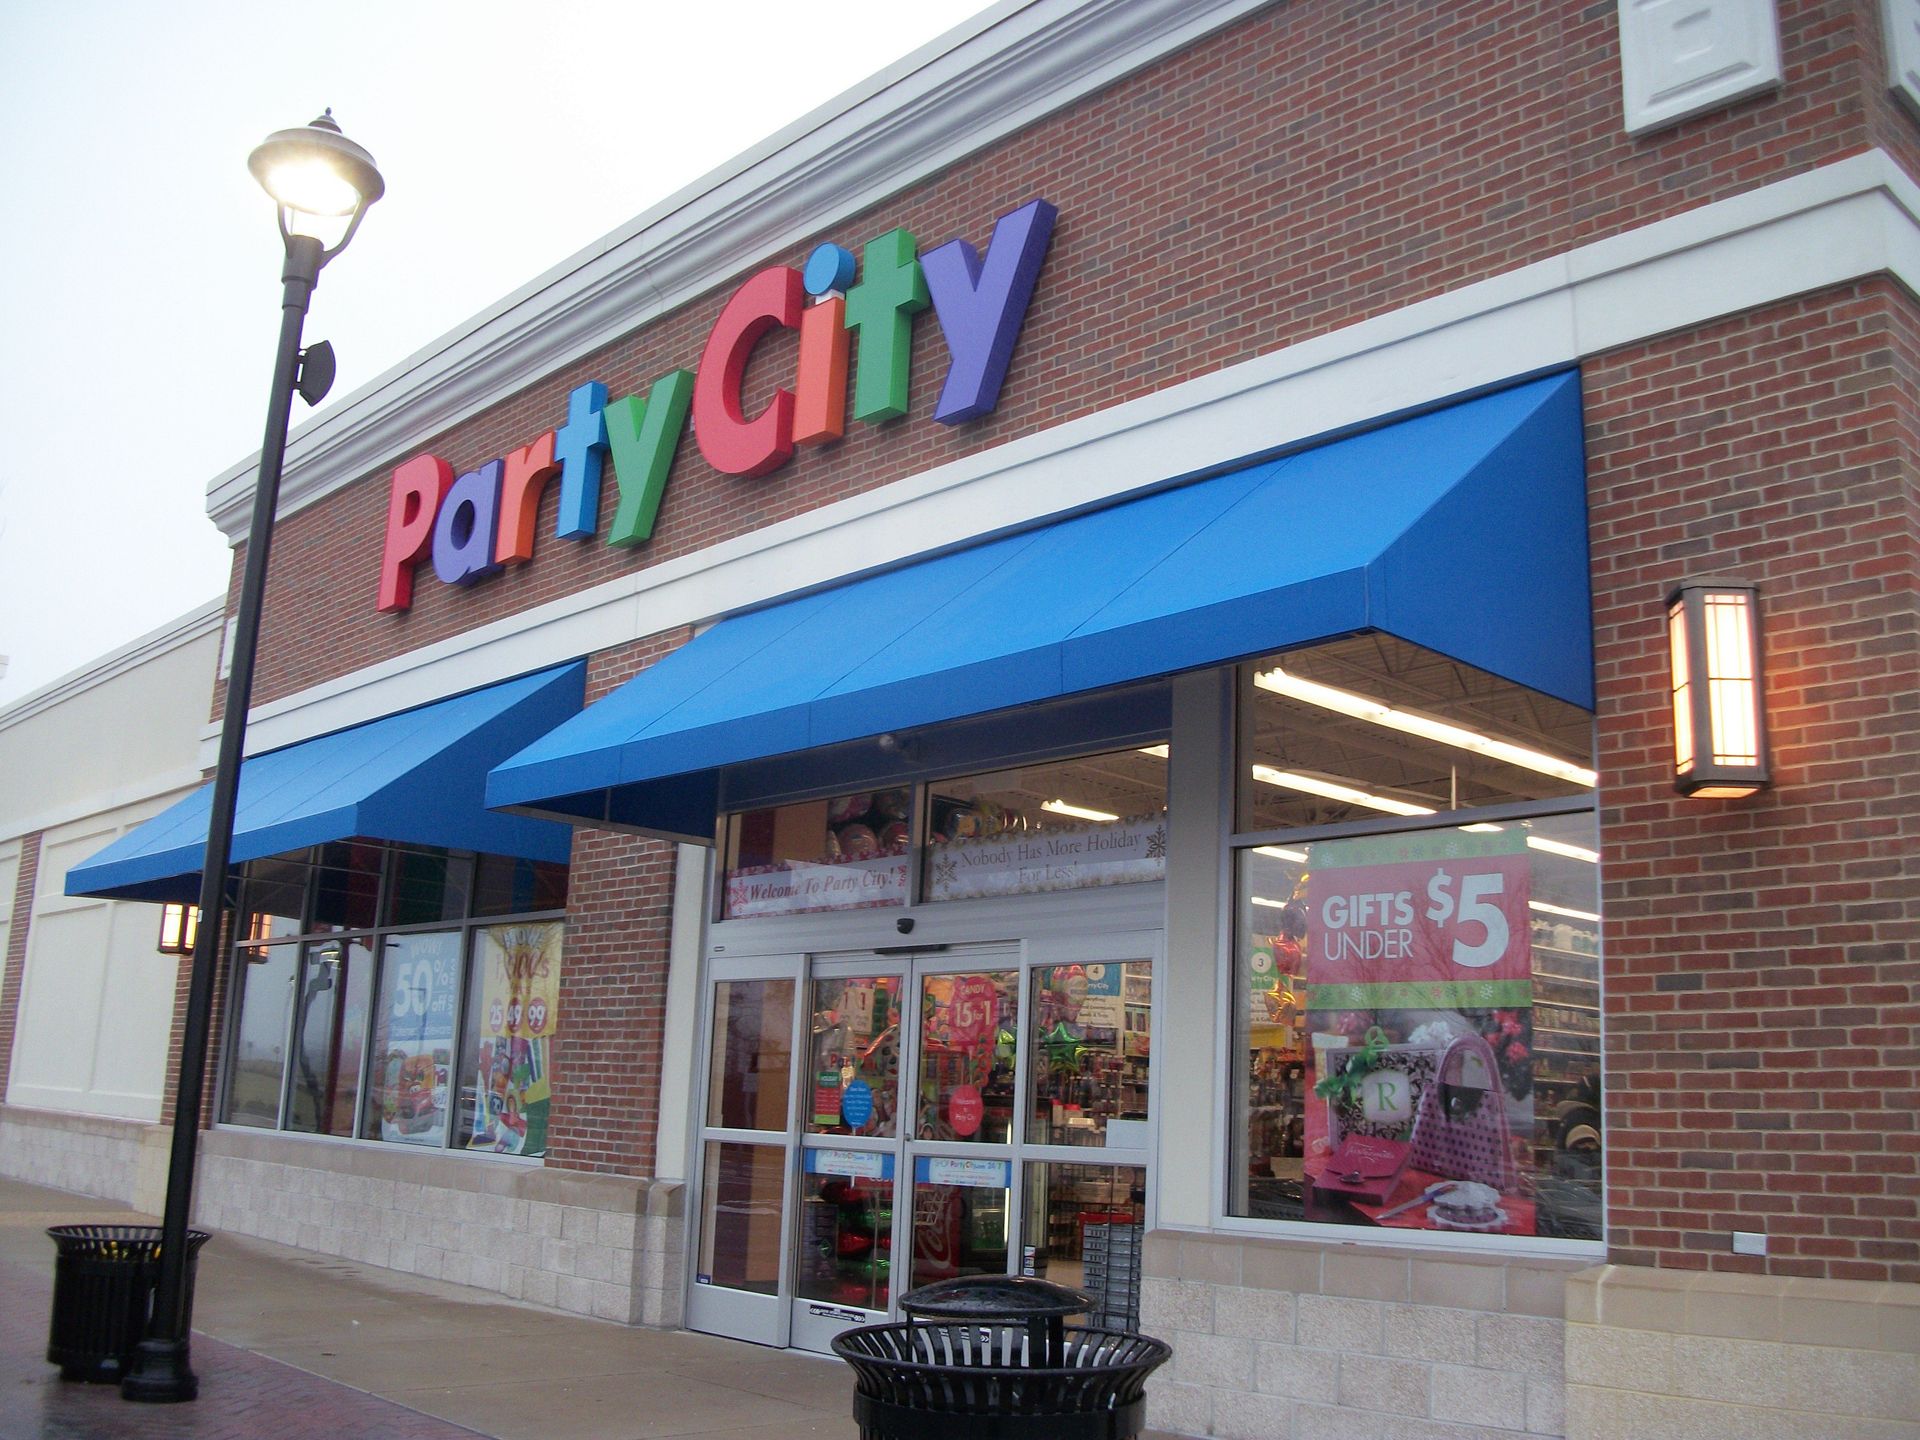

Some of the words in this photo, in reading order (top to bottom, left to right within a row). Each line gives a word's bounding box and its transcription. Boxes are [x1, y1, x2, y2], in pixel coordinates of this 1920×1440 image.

[961, 847, 1012, 868] Nobody
[1018, 844, 1042, 861] Has
[1047, 839, 1082, 857] More
[1087, 829, 1141, 851] Holiday
[750, 883, 799, 901] Welcome
[801, 877, 819, 895] To
[823, 874, 858, 894] Party
[1018, 866, 1041, 884] For
[1321, 891, 1415, 929] GIFTS
[1323, 929, 1414, 961] UNDER
[1258, 958, 1265, 967] 3
[960, 984, 985, 996] CANDY
[528, 1004, 545, 1026] 99
[1376, 1081, 1399, 1112] R
